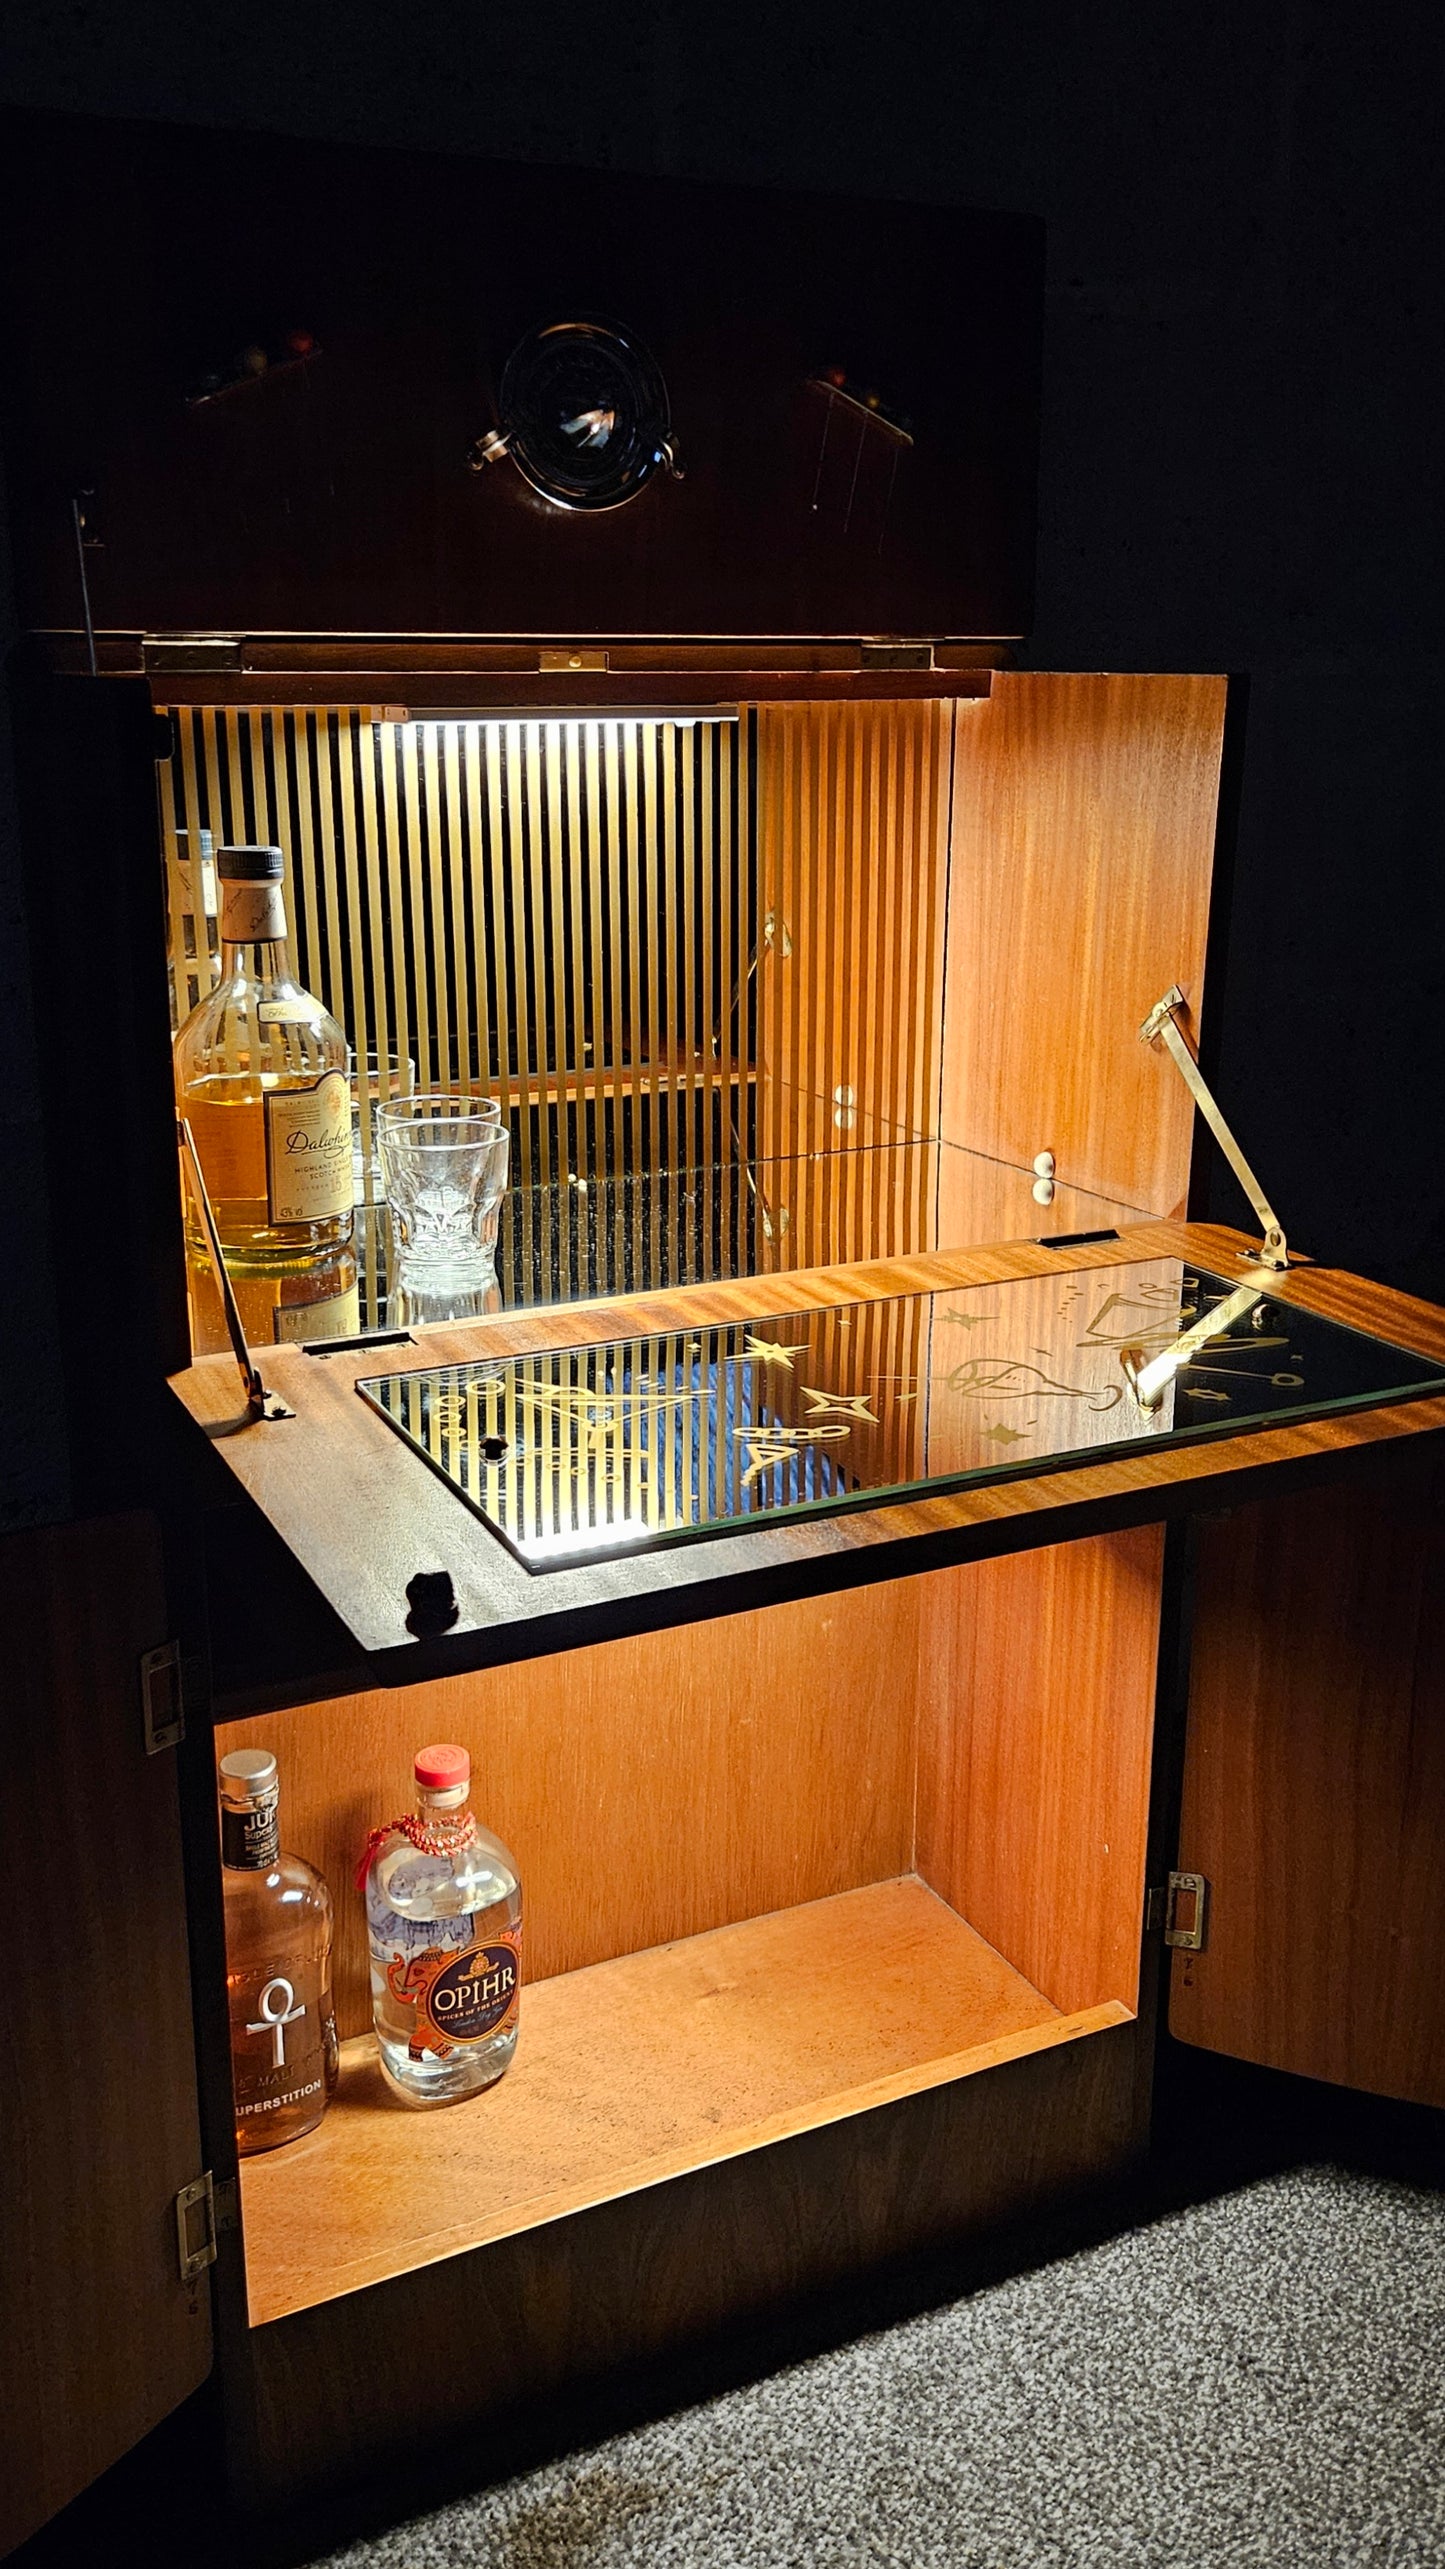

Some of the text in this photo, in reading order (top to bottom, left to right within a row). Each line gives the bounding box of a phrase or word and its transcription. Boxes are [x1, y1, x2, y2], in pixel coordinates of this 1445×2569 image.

[285, 1125, 350, 1158] Dalwhin
[295, 1161, 332, 1174] HIGHLAND
[434, 1966, 516, 2011] OPIHR
[437, 2011, 464, 2022] SPICES
[477, 2003, 491, 2012] THE
[491, 1989, 514, 2006] ORIENT
[236, 2079, 322, 2116] UPERSTITION
